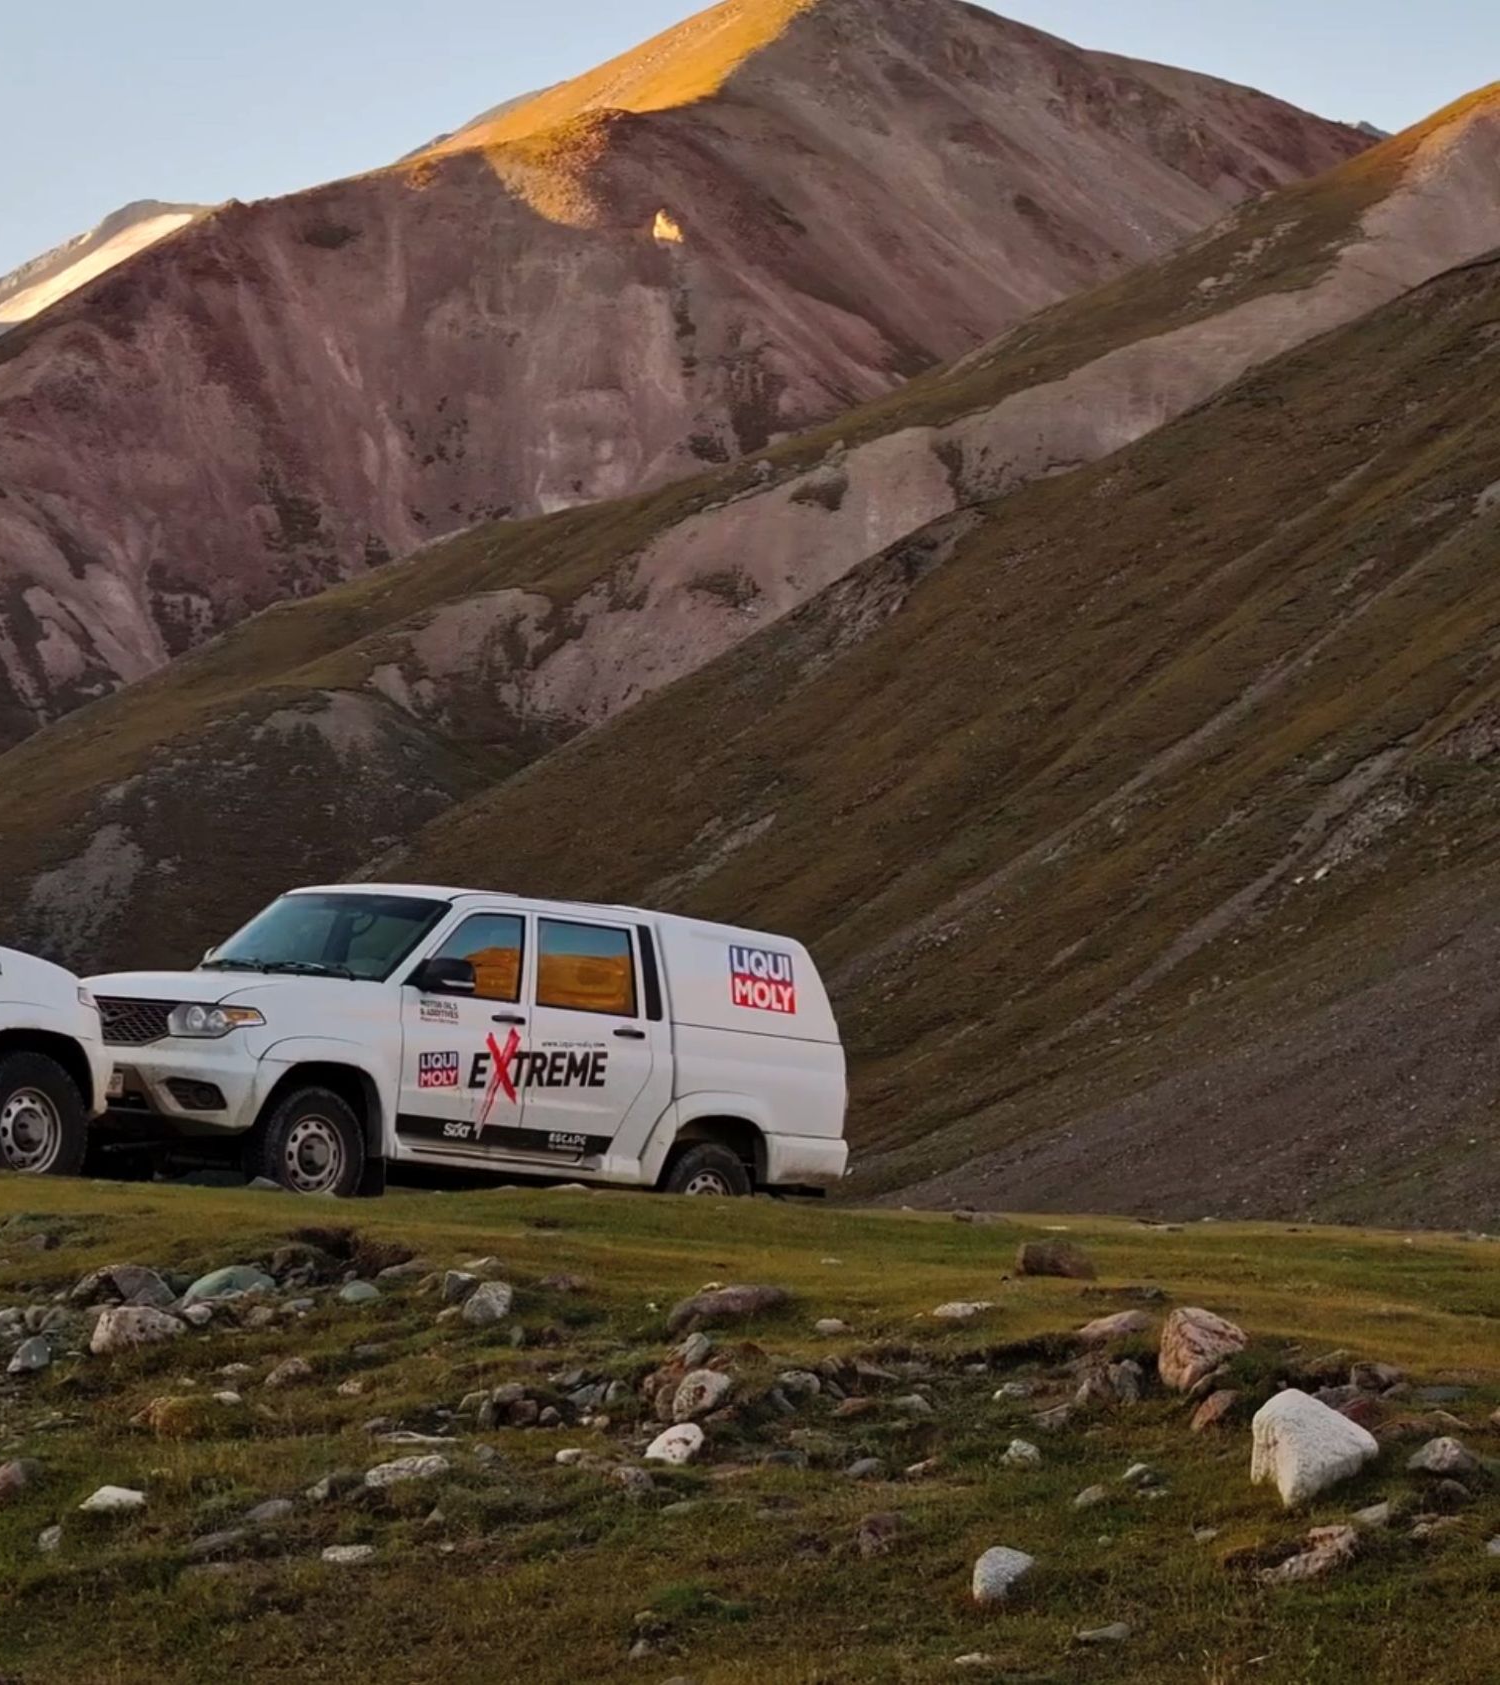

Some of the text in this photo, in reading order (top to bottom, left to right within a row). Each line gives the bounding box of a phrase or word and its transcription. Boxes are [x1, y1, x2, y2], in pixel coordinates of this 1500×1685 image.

[732, 948, 791, 982] LIQUI
[734, 977, 793, 1012] MOLY
[421, 1052, 457, 1069] LIQUI
[420, 1070, 457, 1087] MOLY
